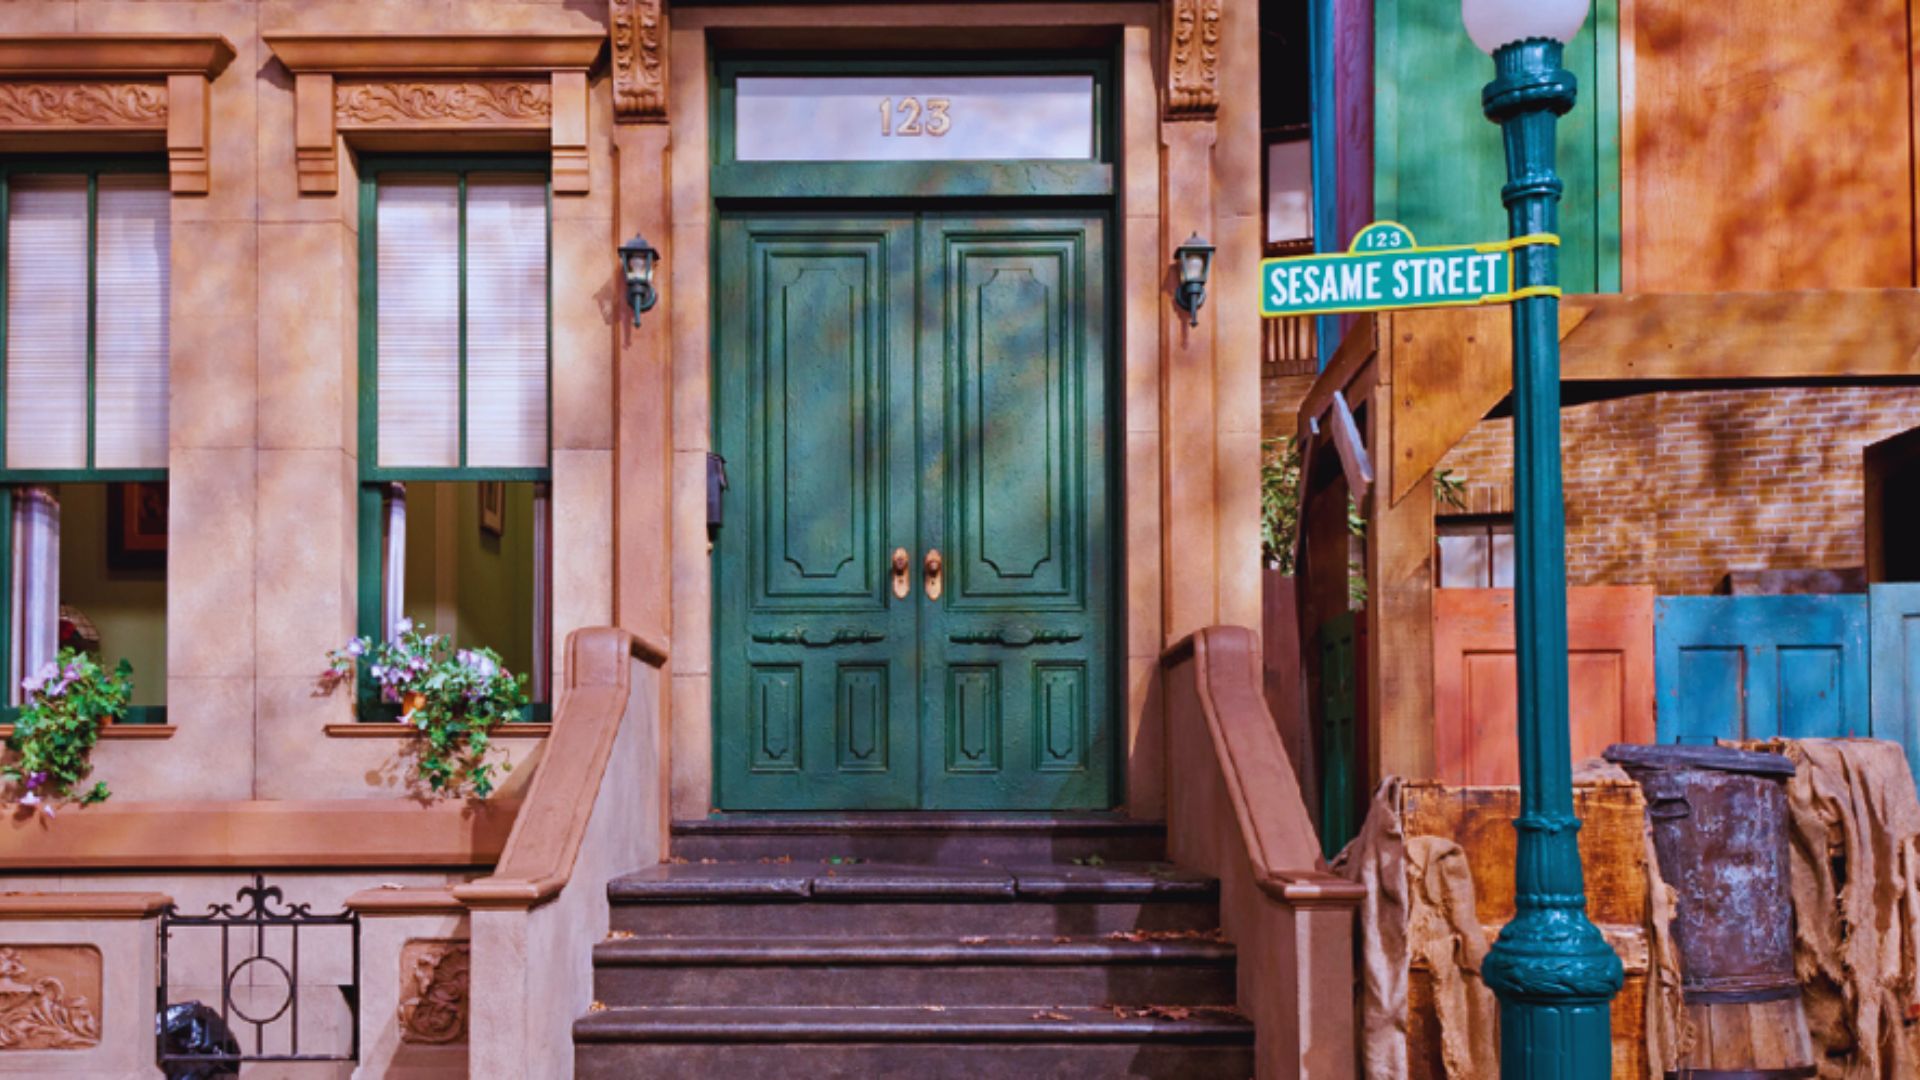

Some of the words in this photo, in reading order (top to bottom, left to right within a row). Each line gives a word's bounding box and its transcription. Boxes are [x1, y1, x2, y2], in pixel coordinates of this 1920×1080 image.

[879, 97, 951, 136] 123
[1366, 231, 1401, 247] 123
[1270, 262, 1382, 305] SESAME
[1392, 254, 1502, 299] STREET
